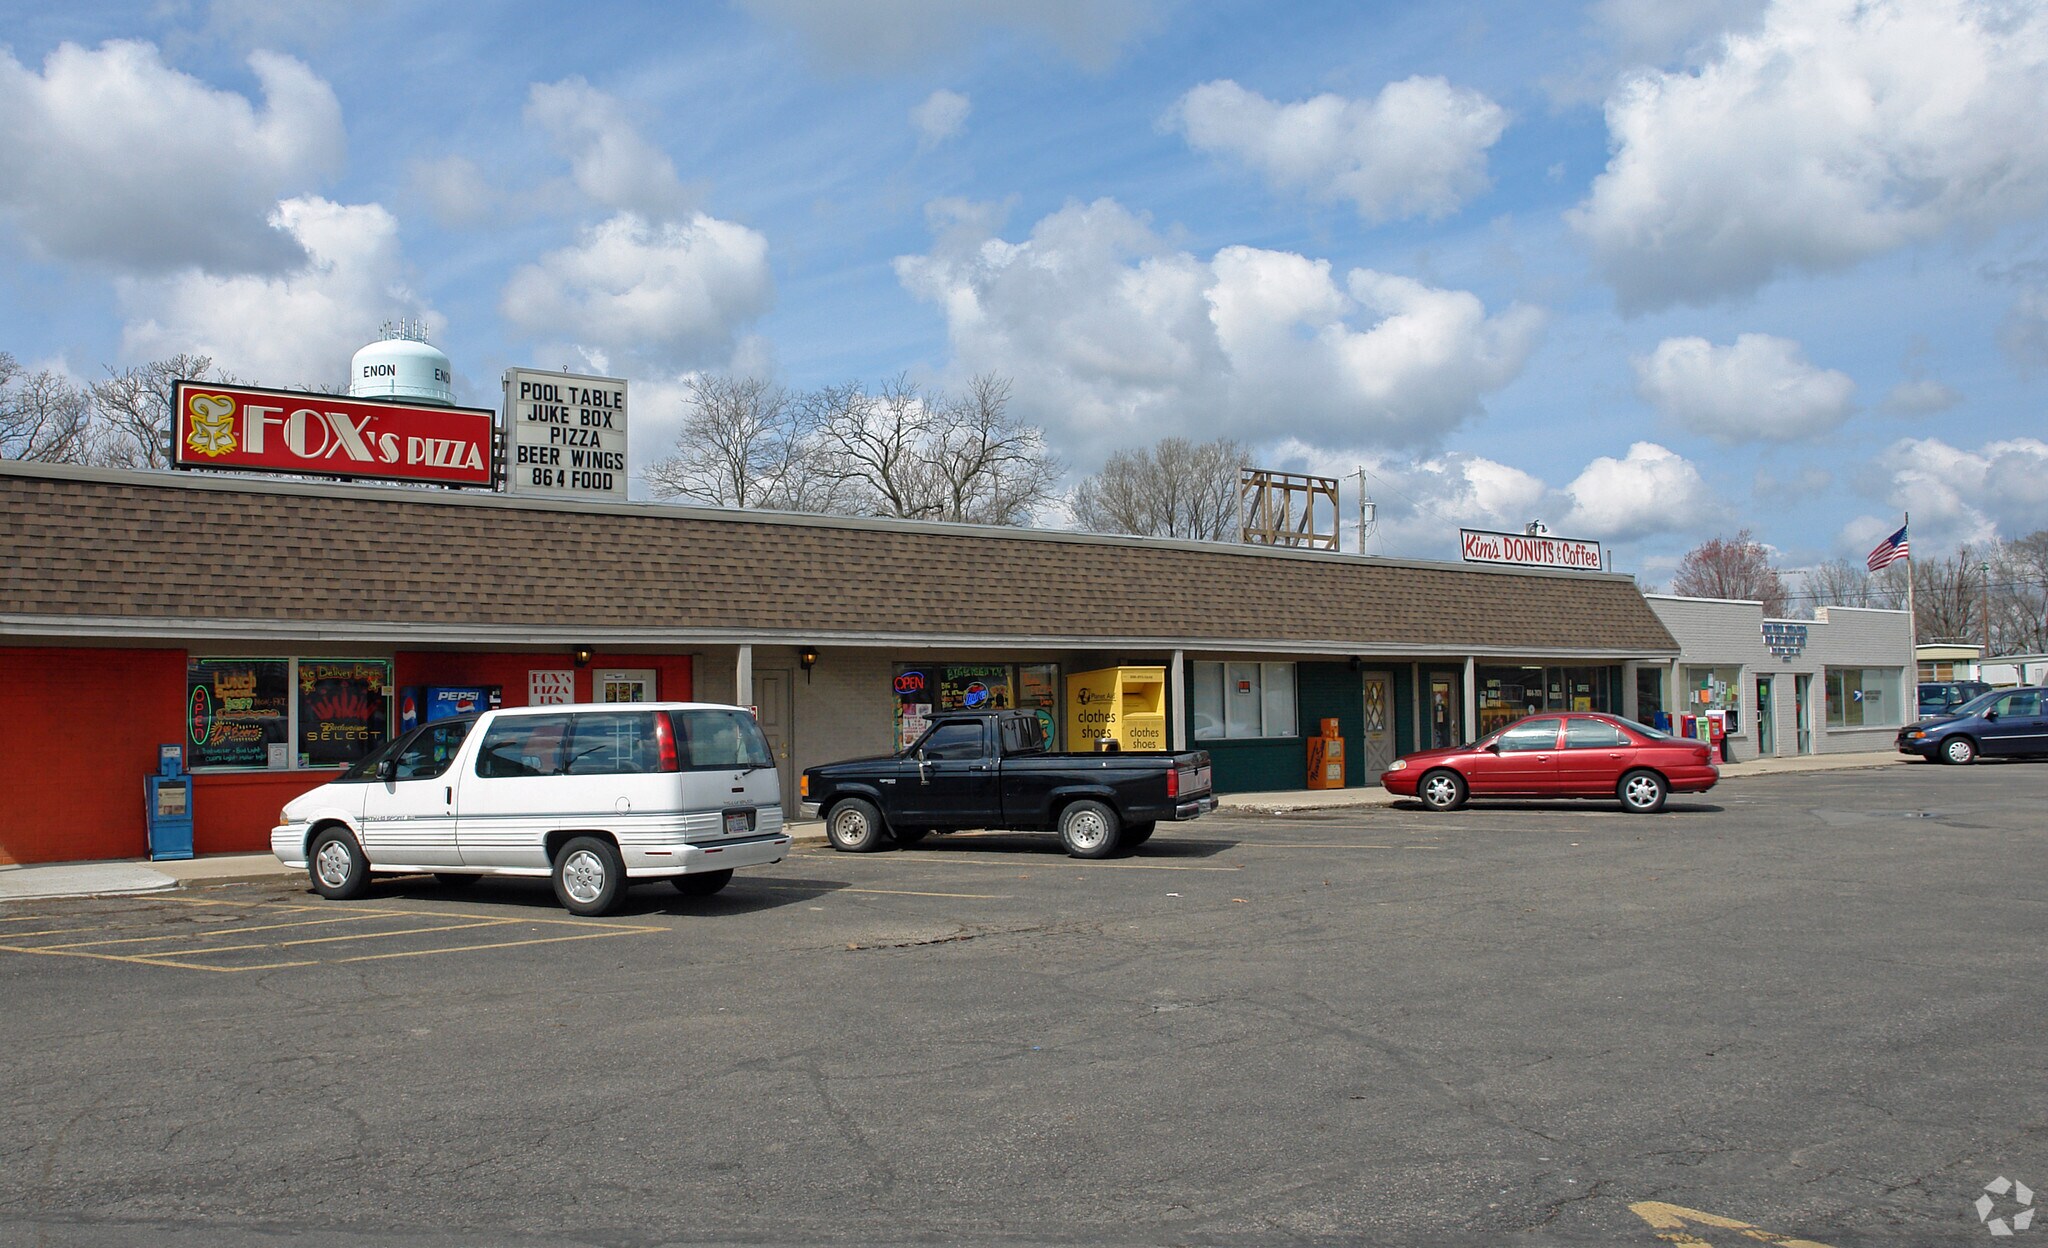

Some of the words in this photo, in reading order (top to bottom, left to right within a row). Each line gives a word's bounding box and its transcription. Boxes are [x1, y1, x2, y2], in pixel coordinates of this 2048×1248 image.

[364, 364, 395, 378] ENON
[434, 368, 450, 384] ENO
[520, 381, 563, 403] POOL
[568, 387, 622, 409] TABLE
[528, 404, 569, 424] JUKE
[580, 409, 613, 429] BOX
[550, 427, 601, 448] PIZZA
[407, 436, 484, 470] PIZZA
[518, 445, 560, 466] BEER
[571, 449, 624, 470] WINGS
[532, 468, 565, 488] 864
[572, 471, 613, 490] FOOD
[1503, 537, 1553, 564] DONUTS
[1562, 542, 1598, 567] Coffee
[894, 676, 924, 690] OPEN
[437, 691, 480, 701] PEPSI
[1078, 709, 1116, 723] clothes
[307, 731, 381, 741] SELECT
[1081, 724, 1112, 739] shoes
[1129, 726, 1159, 738] clothes
[1132, 739, 1156, 749] shoes
